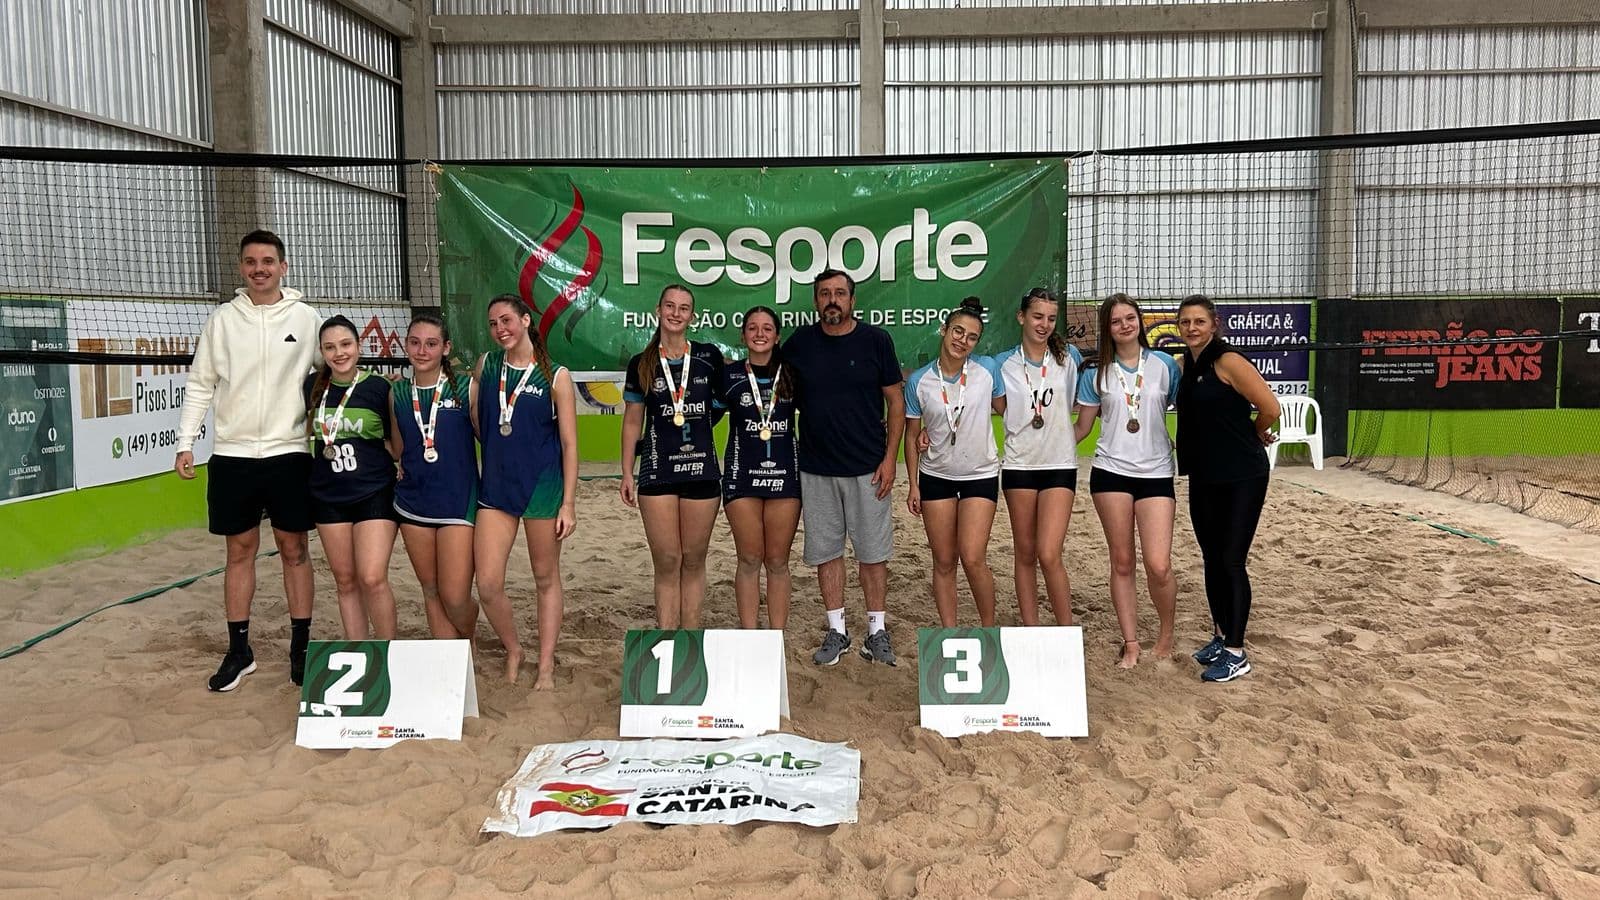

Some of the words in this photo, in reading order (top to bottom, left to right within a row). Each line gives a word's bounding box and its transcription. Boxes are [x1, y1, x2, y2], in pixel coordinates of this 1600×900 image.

[621, 207, 989, 304] Fesporte
[623, 309, 726, 332] FUNÇÃO
[870, 309, 896, 325] DE
[902, 307, 990, 325] ESPOE
[1228, 311, 1281, 330] GRÁFICA
[1283, 313, 1294, 330] &
[135, 336, 200, 377] PINH
[1250, 358, 1282, 375] UAL
[1435, 355, 1542, 388] JEANS
[33, 386, 66, 400] osmoze
[136, 382, 167, 414] Pisos
[1268, 383, 1308, 395] -8212
[659, 400, 706, 417] Zaonel
[127, 434, 149, 458] (49)
[150, 432, 157, 449] 9
[330, 443, 358, 473] 38
[673, 462, 704, 473] BATER
[751, 478, 785, 487] BATER
[323, 651, 367, 706] 2
[651, 639, 675, 694] 1
[942, 638, 983, 694] 3
[639, 783, 756, 799] SANTA
[636, 794, 816, 816] CATARINA
